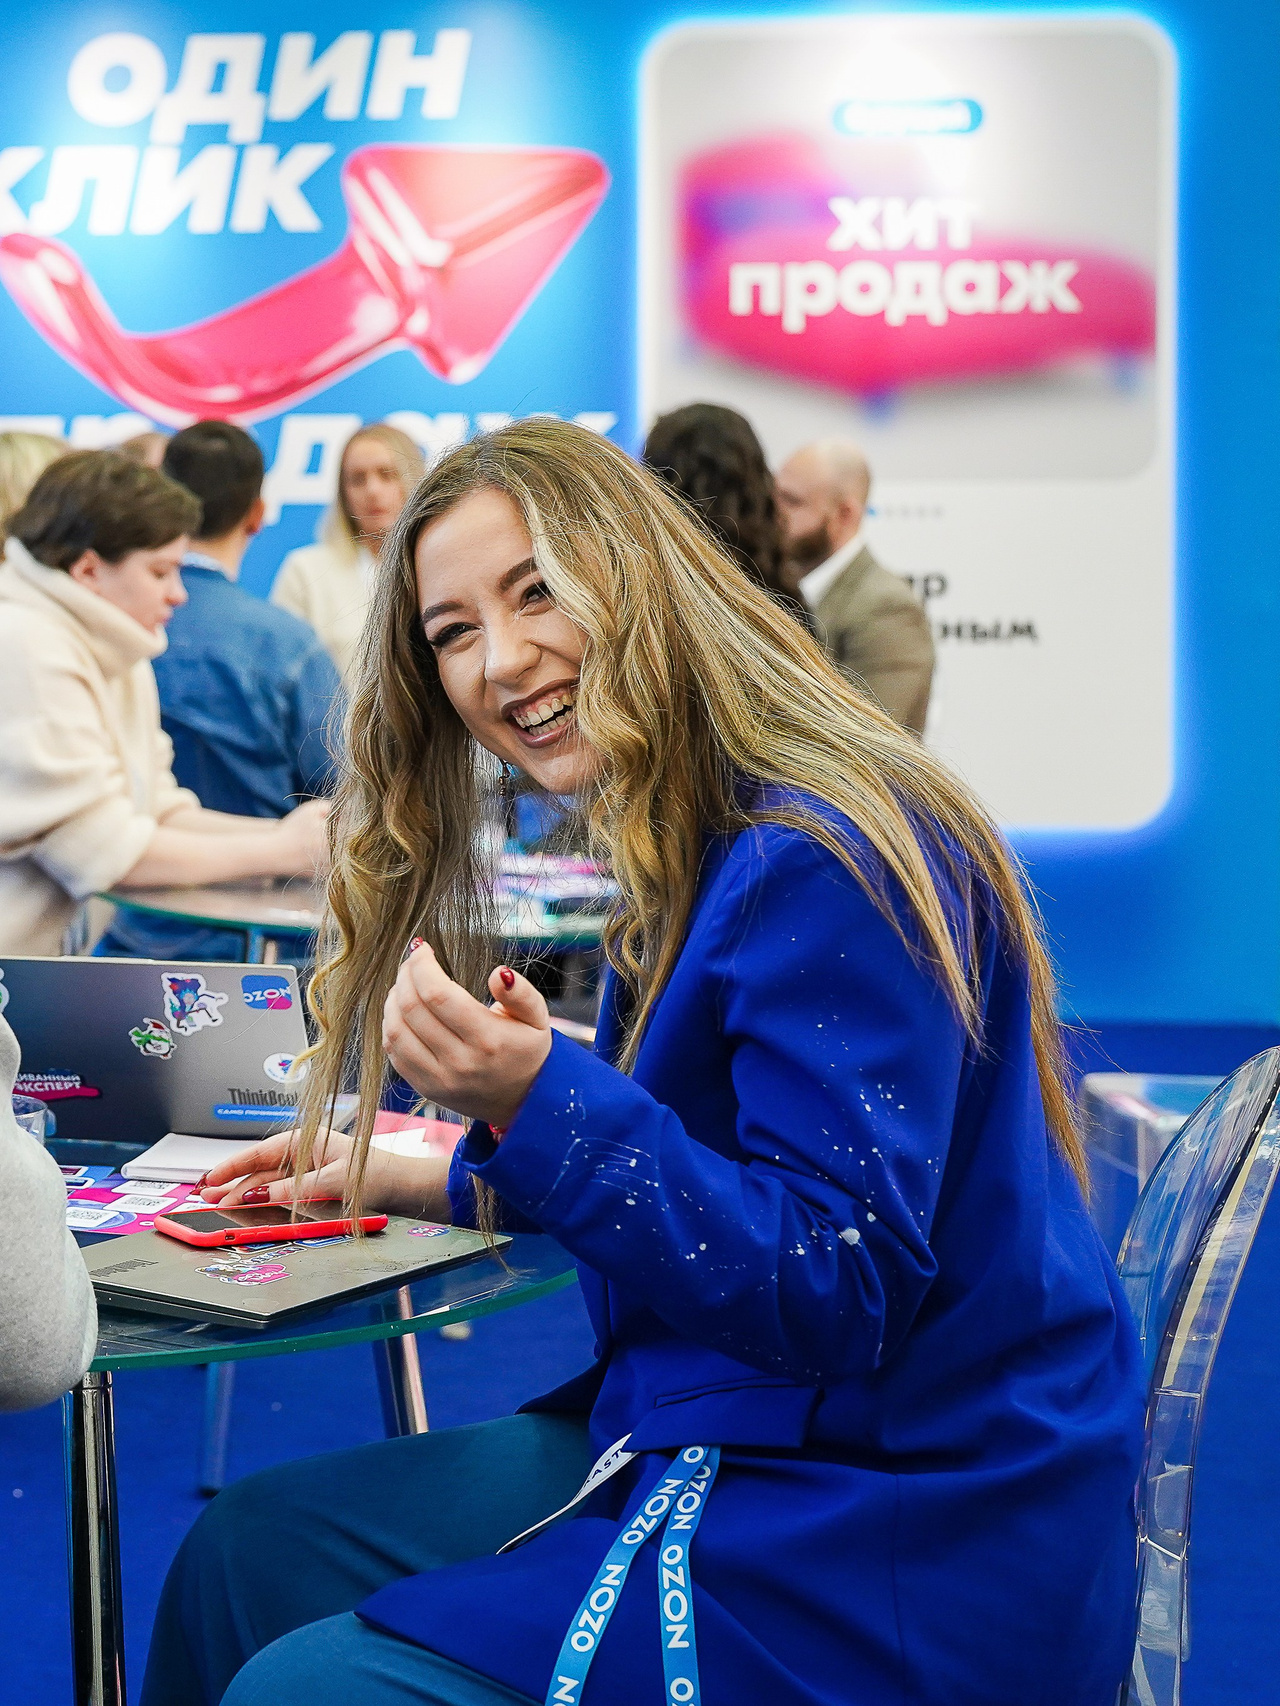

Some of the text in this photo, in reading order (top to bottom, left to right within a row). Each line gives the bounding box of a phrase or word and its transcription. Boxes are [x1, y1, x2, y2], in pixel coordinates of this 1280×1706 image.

[622, 1478, 684, 1545] OZON
[570, 1564, 626, 1653] OZON
[662, 1544, 690, 1649] OZON
